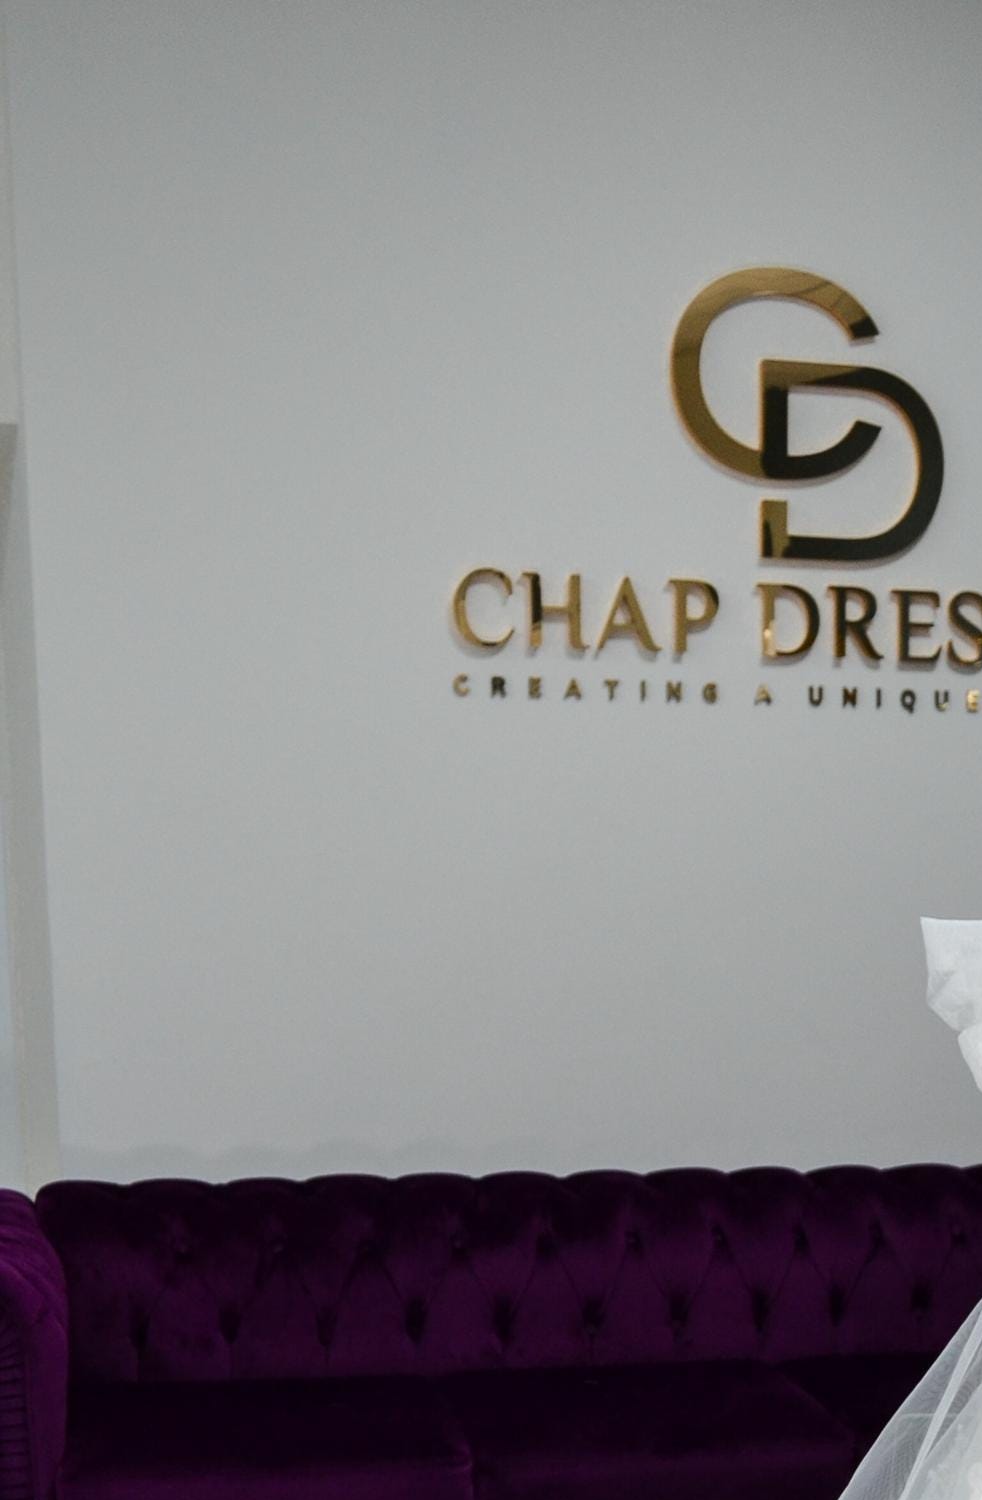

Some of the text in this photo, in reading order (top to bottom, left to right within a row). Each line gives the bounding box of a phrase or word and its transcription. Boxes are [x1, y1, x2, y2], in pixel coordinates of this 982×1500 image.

[451, 567, 720, 654] CHAP
[452, 673, 719, 704] CREATING
[754, 684, 773, 706] A
[807, 684, 981, 713] UNIQUE
